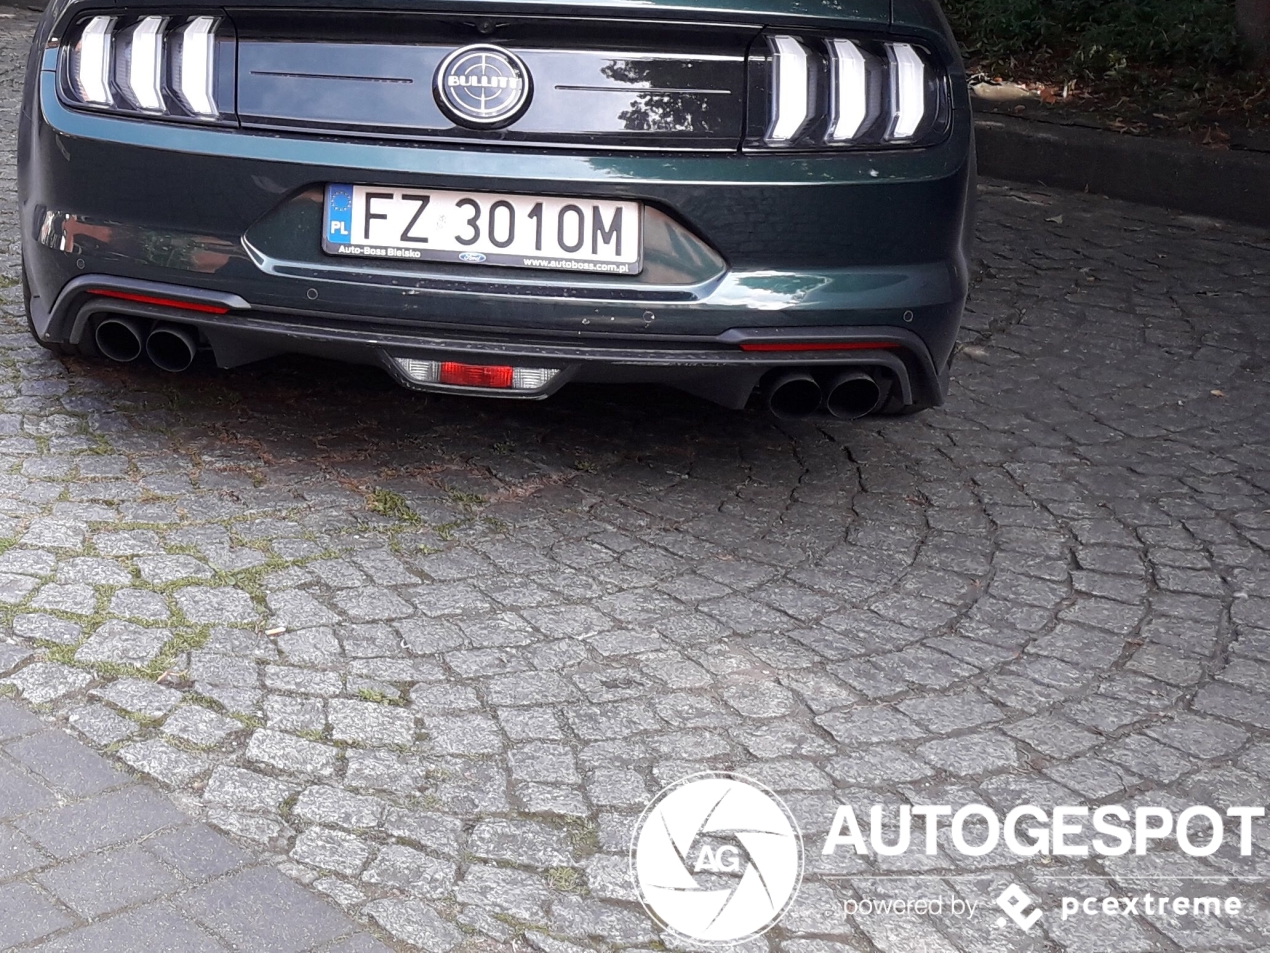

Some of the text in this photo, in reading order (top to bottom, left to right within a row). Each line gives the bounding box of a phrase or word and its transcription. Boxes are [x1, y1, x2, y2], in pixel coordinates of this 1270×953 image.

[448, 75, 522, 90] BULLITT
[330, 220, 349, 235] PL
[363, 192, 623, 256] FZ 3010M
[338, 244, 421, 259] Auto-Boss Bielsko
[523, 257, 629, 274] www.autoboss.com.pl
